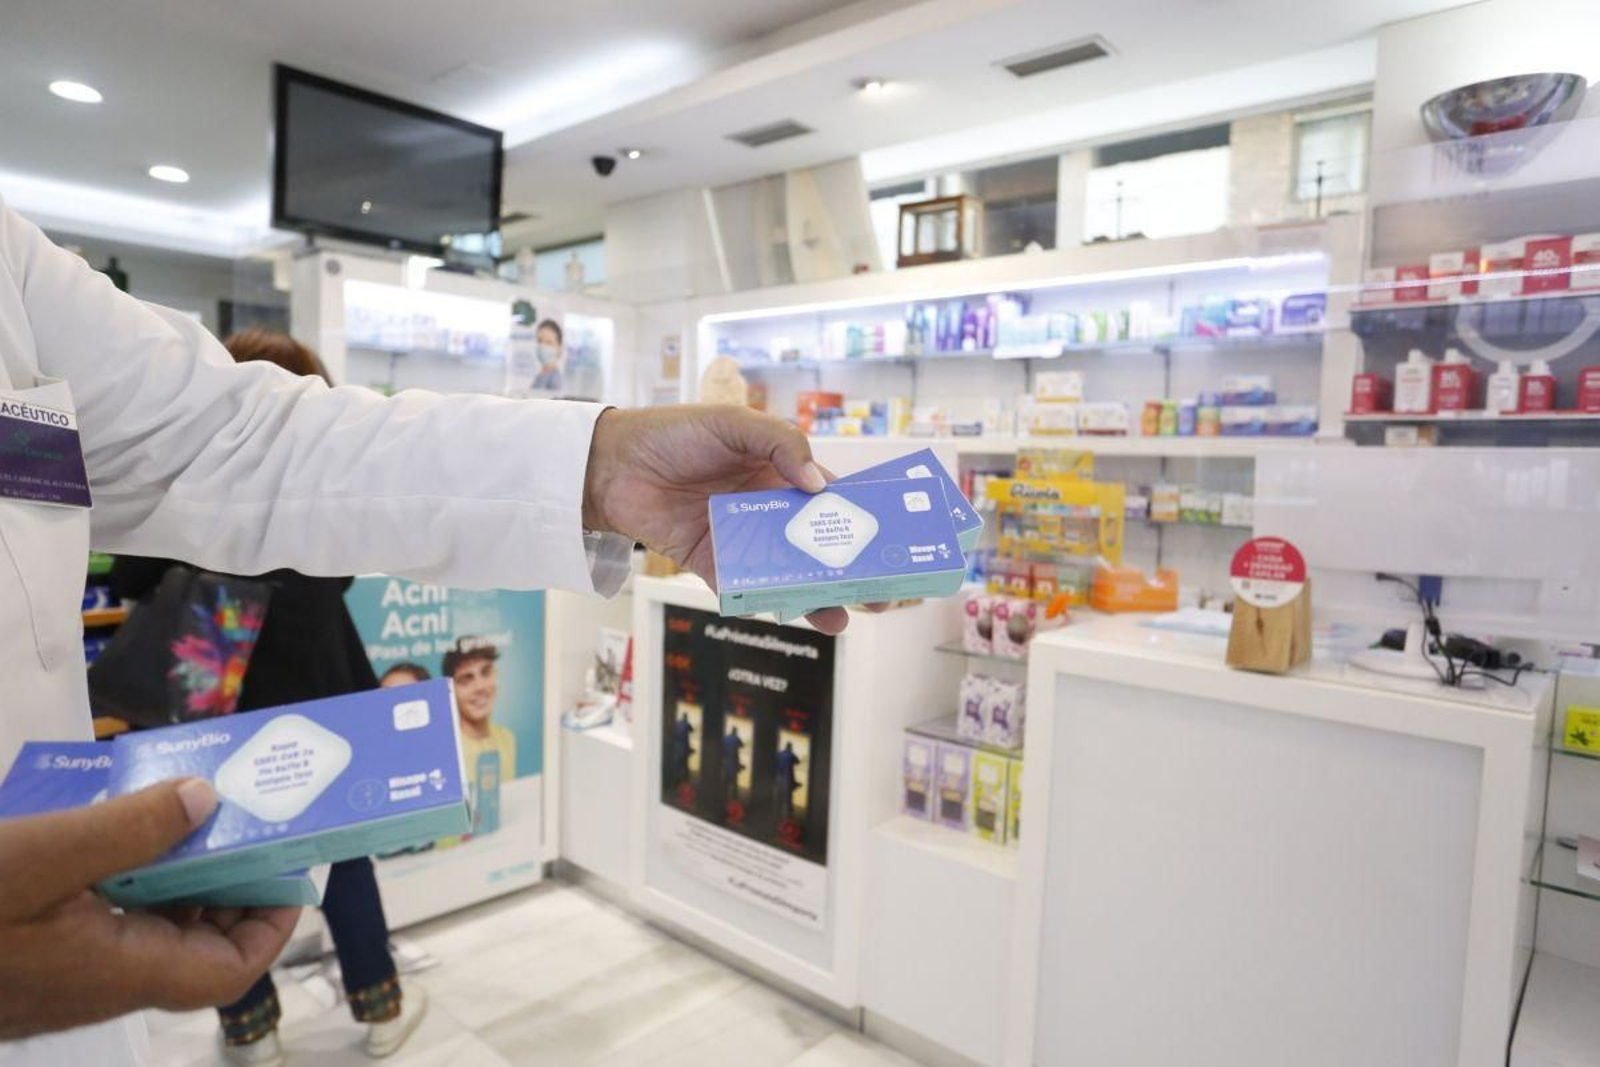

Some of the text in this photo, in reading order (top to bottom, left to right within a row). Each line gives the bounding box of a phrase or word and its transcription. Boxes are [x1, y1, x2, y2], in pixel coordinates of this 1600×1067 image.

[0, 402, 70, 426] ACÉUTICO
[740, 500, 790, 511] SunyBio
[411, 640, 432, 657] de
[156, 733, 231, 754] SunyBio
[54, 755, 112, 771] SunyBi
